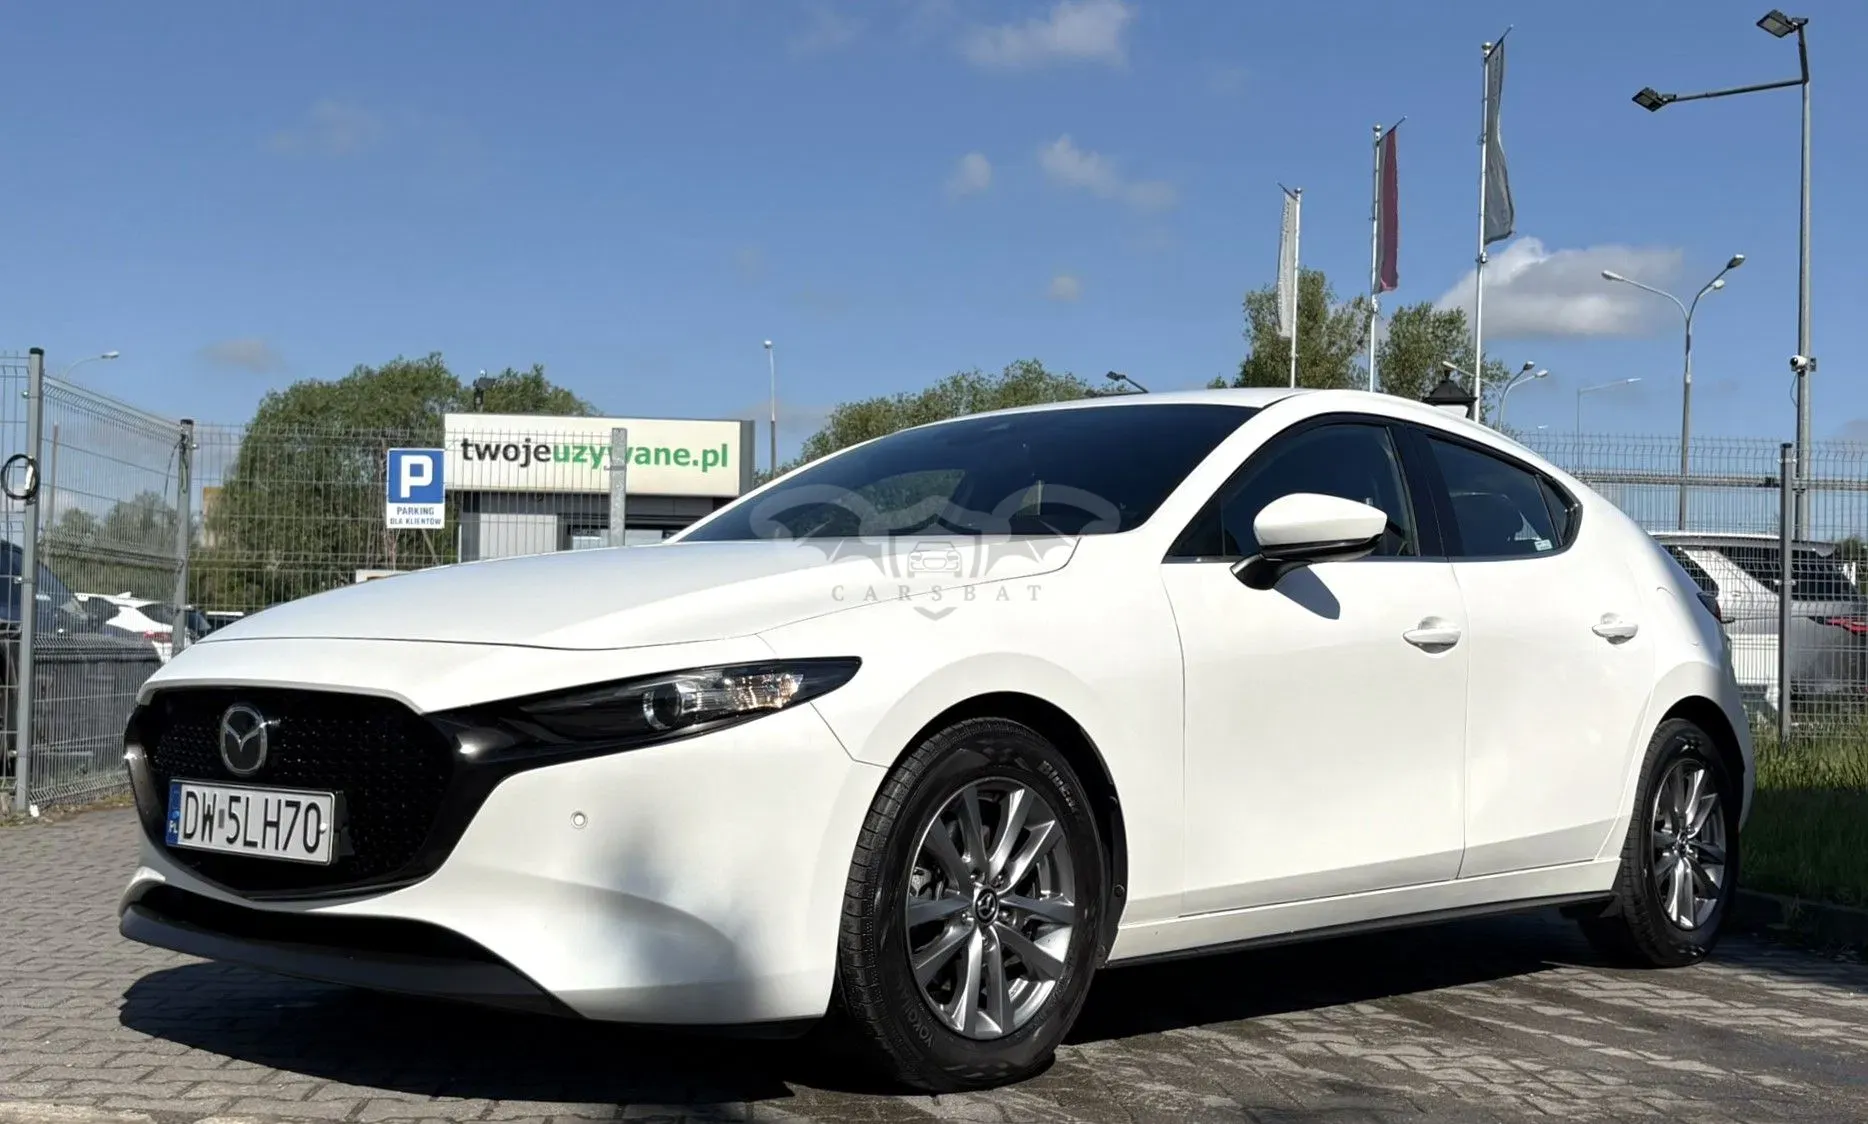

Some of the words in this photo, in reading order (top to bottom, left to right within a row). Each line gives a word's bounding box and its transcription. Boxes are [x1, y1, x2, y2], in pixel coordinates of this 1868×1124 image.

[401, 455, 433, 498] P
[397, 506, 434, 515] PARKING
[183, 791, 217, 843] DW
[226, 795, 322, 854] 5LH70
